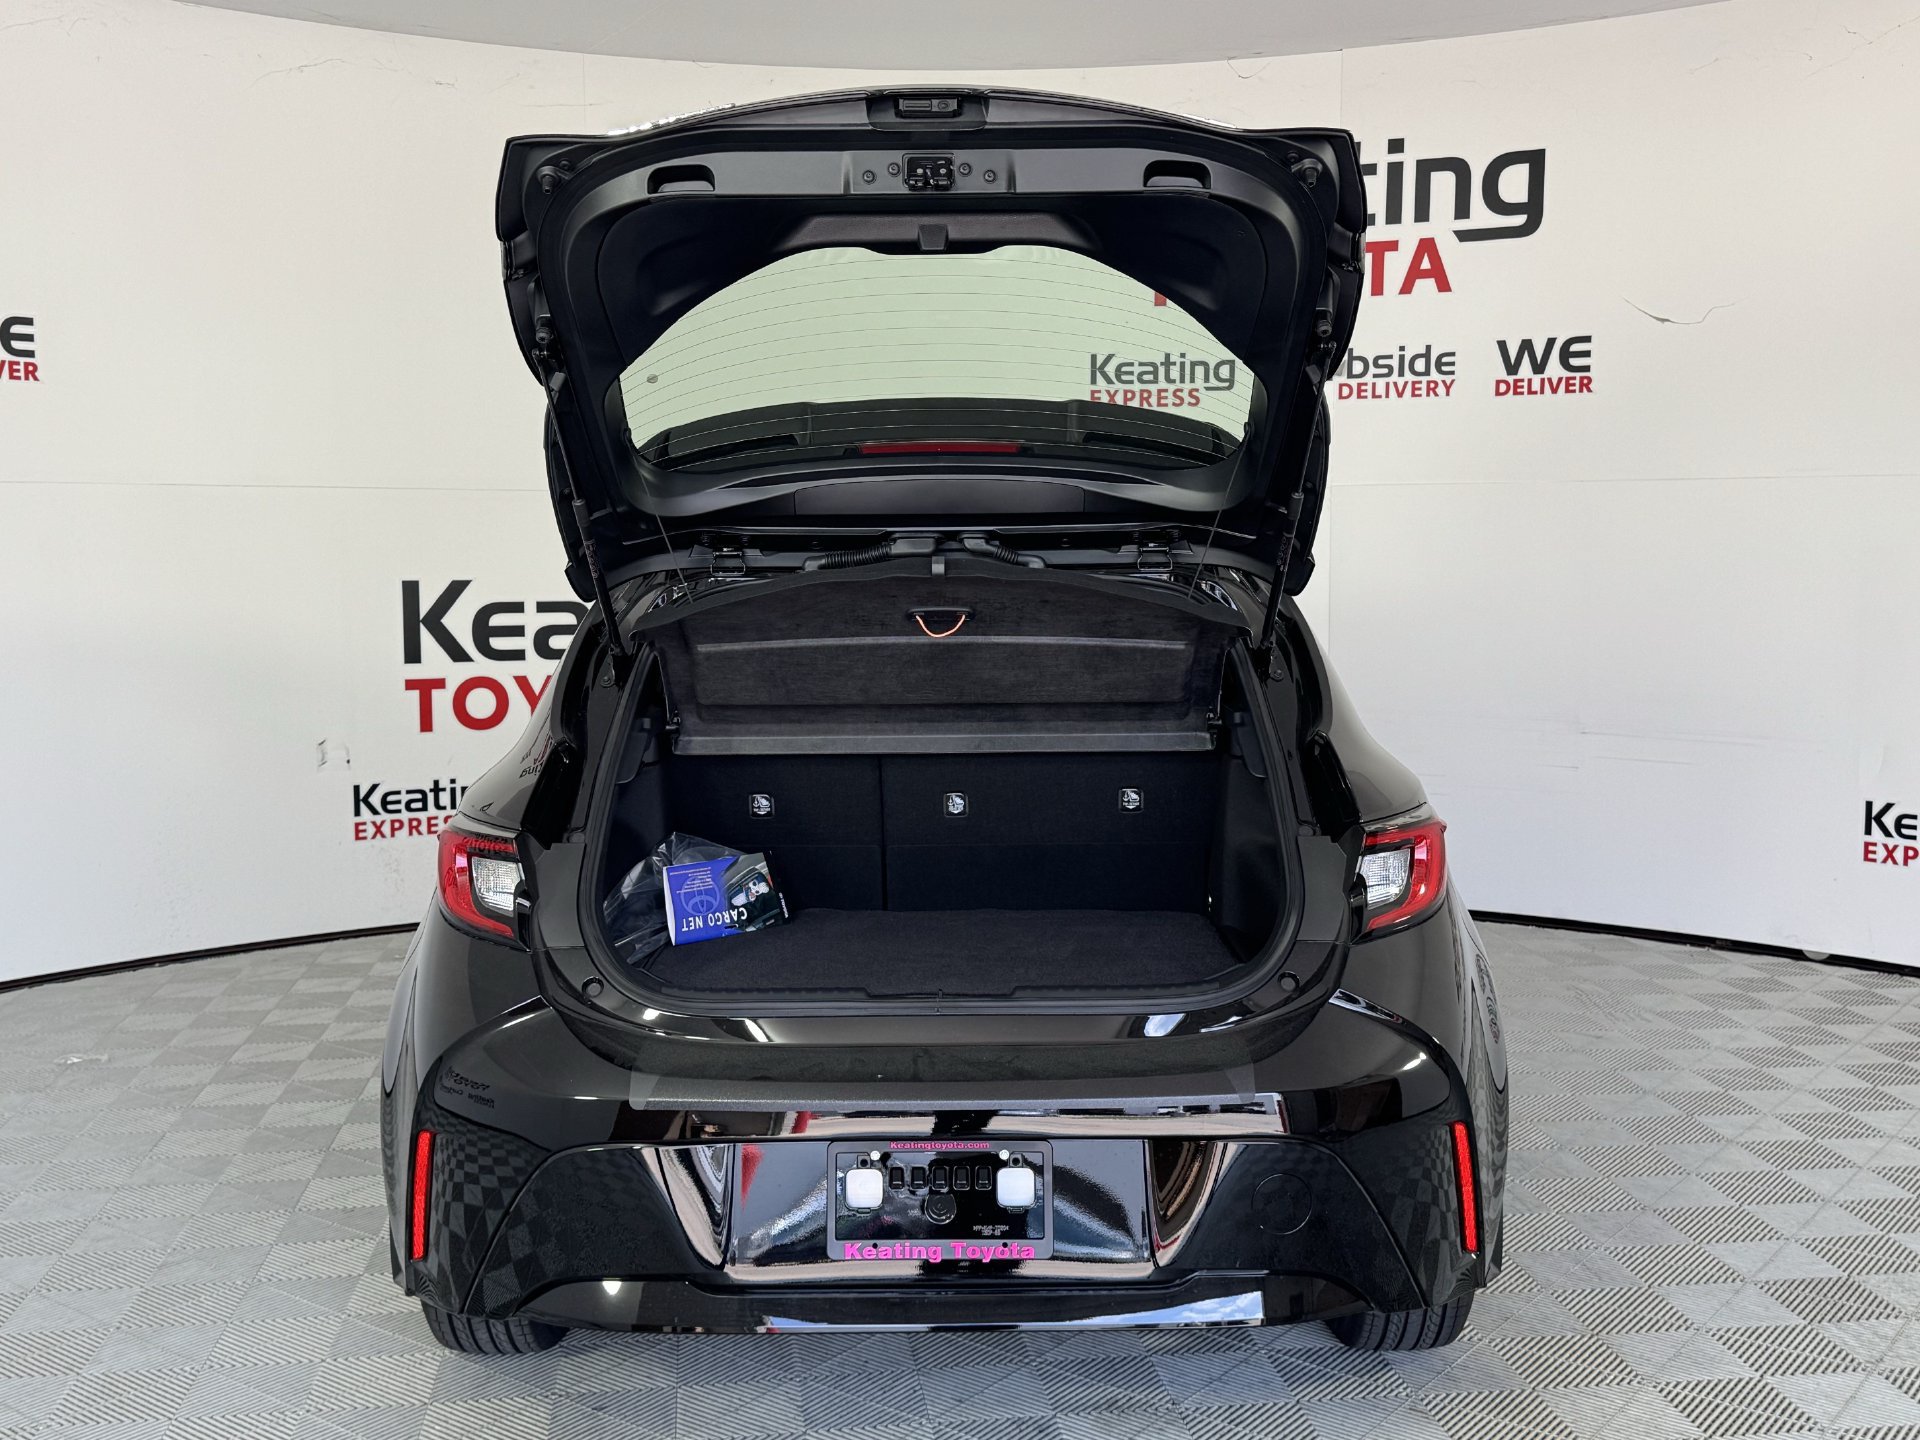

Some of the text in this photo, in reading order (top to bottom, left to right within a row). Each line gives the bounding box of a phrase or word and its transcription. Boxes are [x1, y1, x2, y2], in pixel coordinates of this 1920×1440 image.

[1346, 344, 1456, 379] bside
[1496, 335, 1592, 376] WE
[1090, 352, 1236, 391] Keating
[1090, 388, 1201, 408] EXPRESS
[1338, 378, 1456, 400] DELIVERY
[1494, 375, 1593, 397] DELIVER
[353, 778, 468, 817] Keati
[1864, 800, 1918, 841] Ke
[1863, 841, 1919, 867] EXP
[682, 907, 748, 932] CARGO NET
[890, 1141, 990, 1150] Keatingtoyota.com
[844, 1242, 1035, 1263] Keating Toyota
